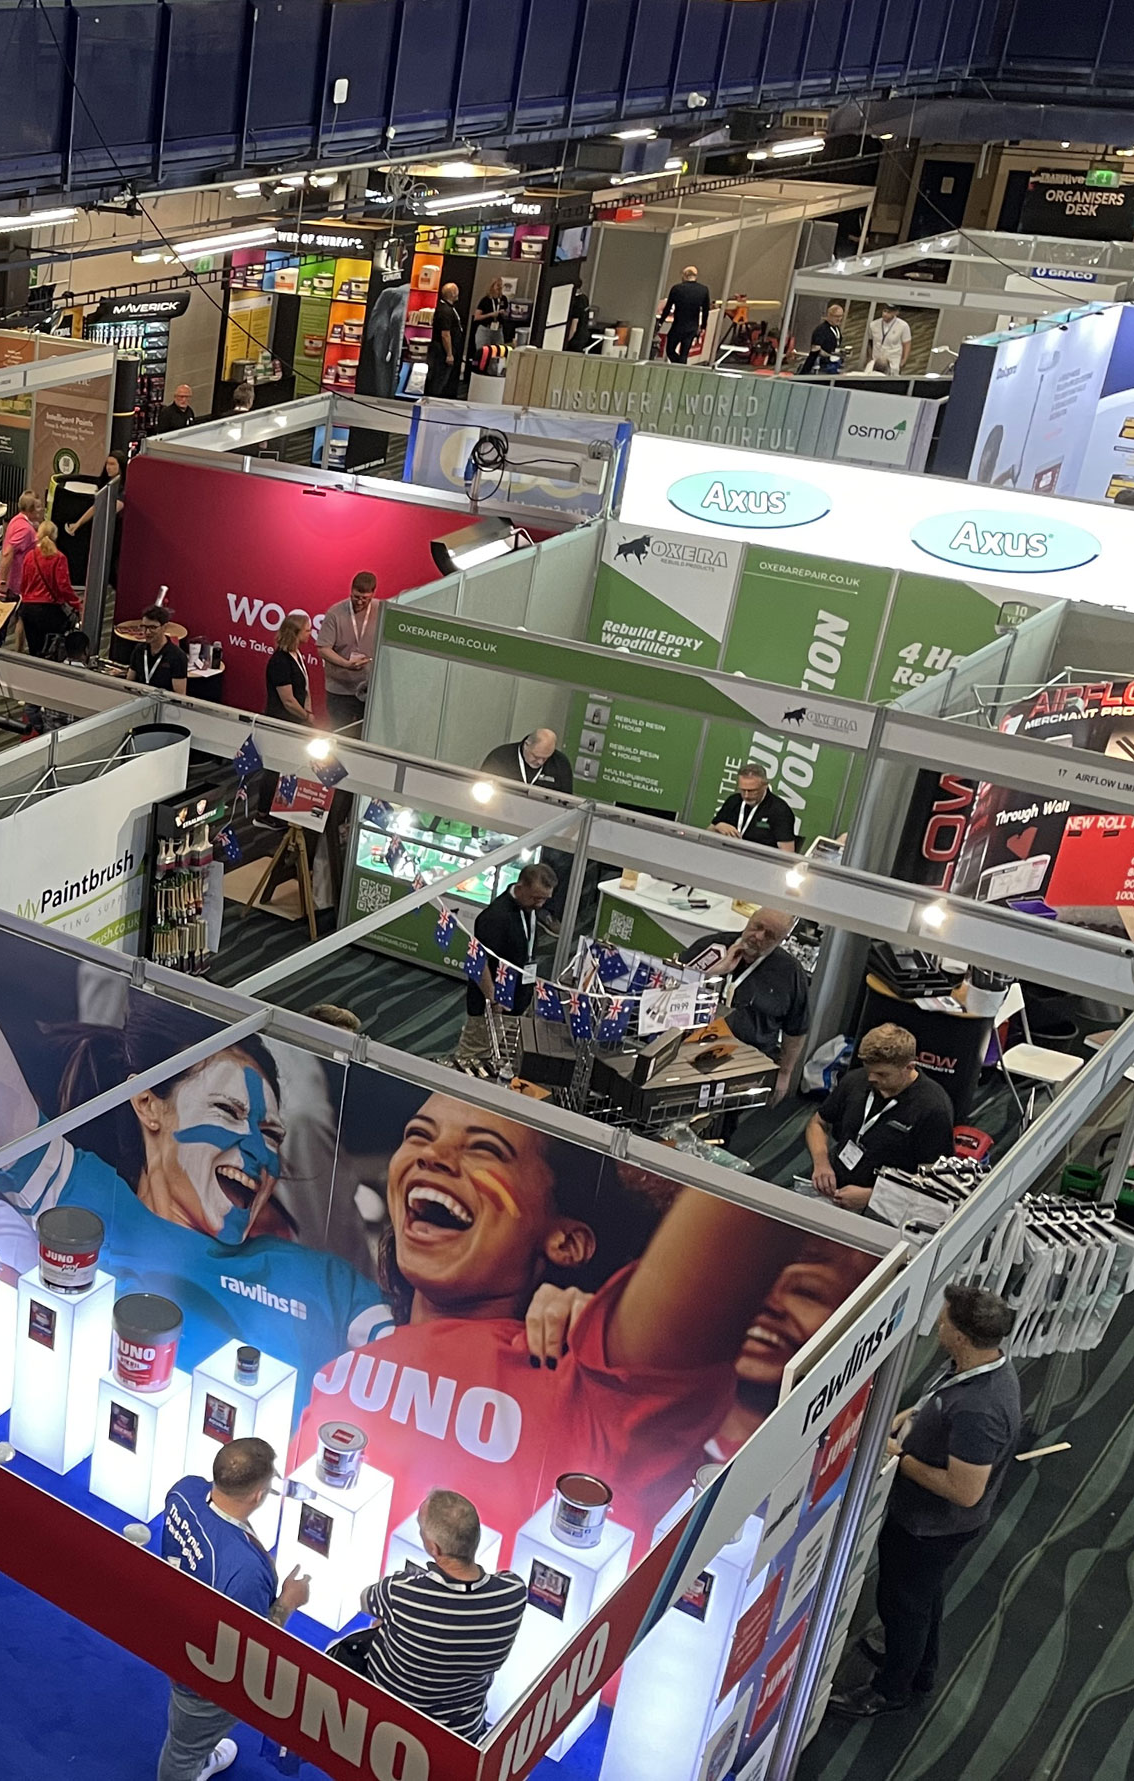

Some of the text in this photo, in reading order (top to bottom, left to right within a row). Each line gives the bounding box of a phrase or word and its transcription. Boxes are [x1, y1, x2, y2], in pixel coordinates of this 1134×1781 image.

[1046, 189, 1125, 206] ORGANISERS
[1065, 204, 1099, 216] DESK
[1048, 269, 1093, 280] GRACO
[113, 301, 180, 315] MAVERICK
[551, 388, 759, 417] DISCOVER A WORLD
[76, 416, 94, 428] Paints
[848, 421, 897, 441] osmo
[701, 481, 787, 516] Axus
[949, 521, 1048, 559] Axus
[651, 540, 728, 568] OXERA
[759, 561, 861, 588] OXERAREPAIR.CO.UK
[1015, 604, 1029, 618] 10
[398, 622, 497, 654] OXERAREPAIR.CO.UK
[601, 631, 682, 659] Woodfillers
[602, 619, 704, 651] Rebuild Epoxy
[229, 633, 319, 666] We Take In
[899, 642, 922, 665] 4
[614, 714, 666, 733] REBUILD RESIN
[621, 724, 642, 735] HOUR
[807, 710, 858, 732] OXERA
[1024, 707, 1099, 731] MERCHANT
[608, 742, 660, 761] REBUILD RESIN
[618, 752, 642, 764] HOURS
[602, 774, 664, 796] GLAZING SEALANT
[604, 767, 660, 787] MULTI-PURPOSE
[1058, 768, 1068, 778] 17
[1075, 772, 1118, 789] AIRFLOW
[995, 799, 1071, 827] Through Wall
[1066, 815, 1128, 831] NEW ROLL
[16, 849, 134, 921] MyPaintbrush
[45, 1249, 74, 1264] JUNO
[220, 1275, 289, 1315] rawlins
[801, 1315, 888, 1436] rawlins
[312, 1350, 523, 1464] JUNO
[819, 1408, 865, 1477] JUNO
[169, 1503, 182, 1527] The
[185, 1619, 431, 1781] JUNO
[497, 1620, 611, 1781] JUNO
